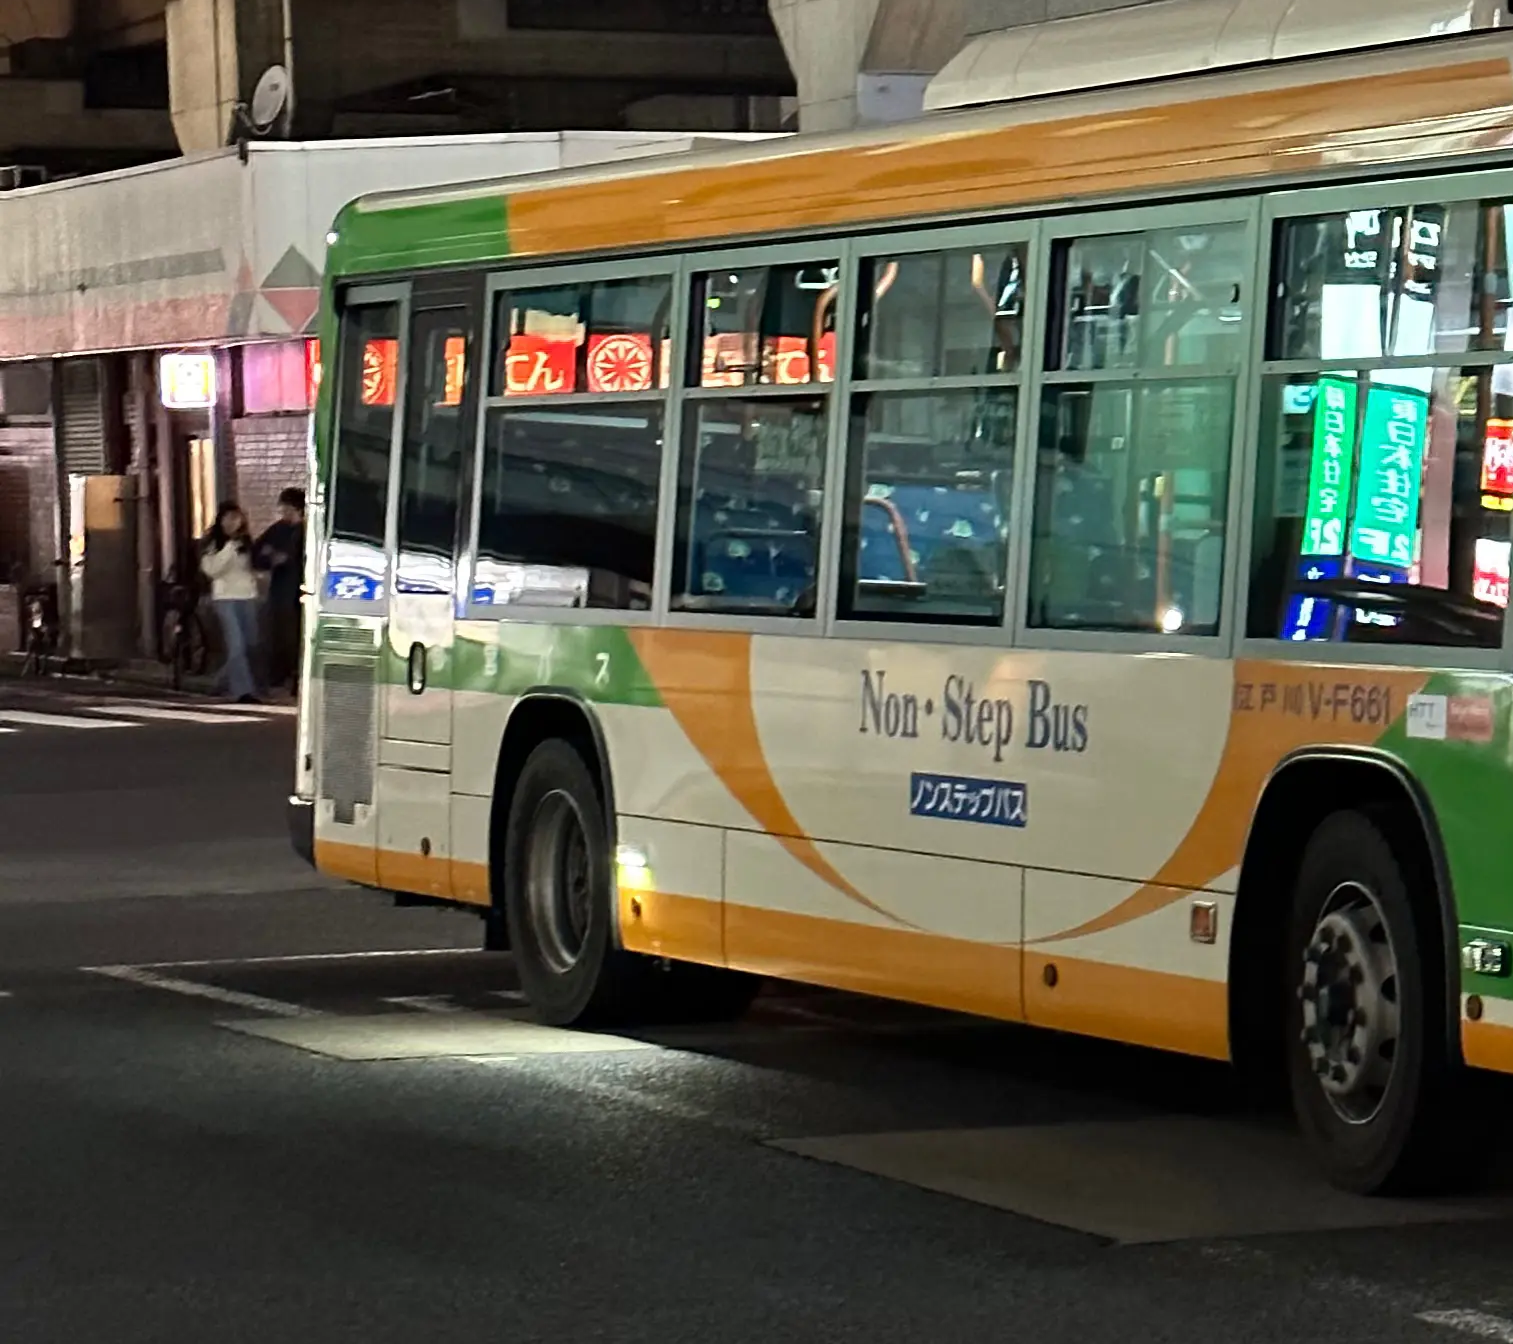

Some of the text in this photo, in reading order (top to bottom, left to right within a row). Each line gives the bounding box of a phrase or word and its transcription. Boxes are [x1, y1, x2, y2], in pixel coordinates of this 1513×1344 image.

[1025, 680, 1088, 753] Bus
[1309, 680, 1391, 726] V-F661
[911, 778, 1028, 822] ノンステップバス
